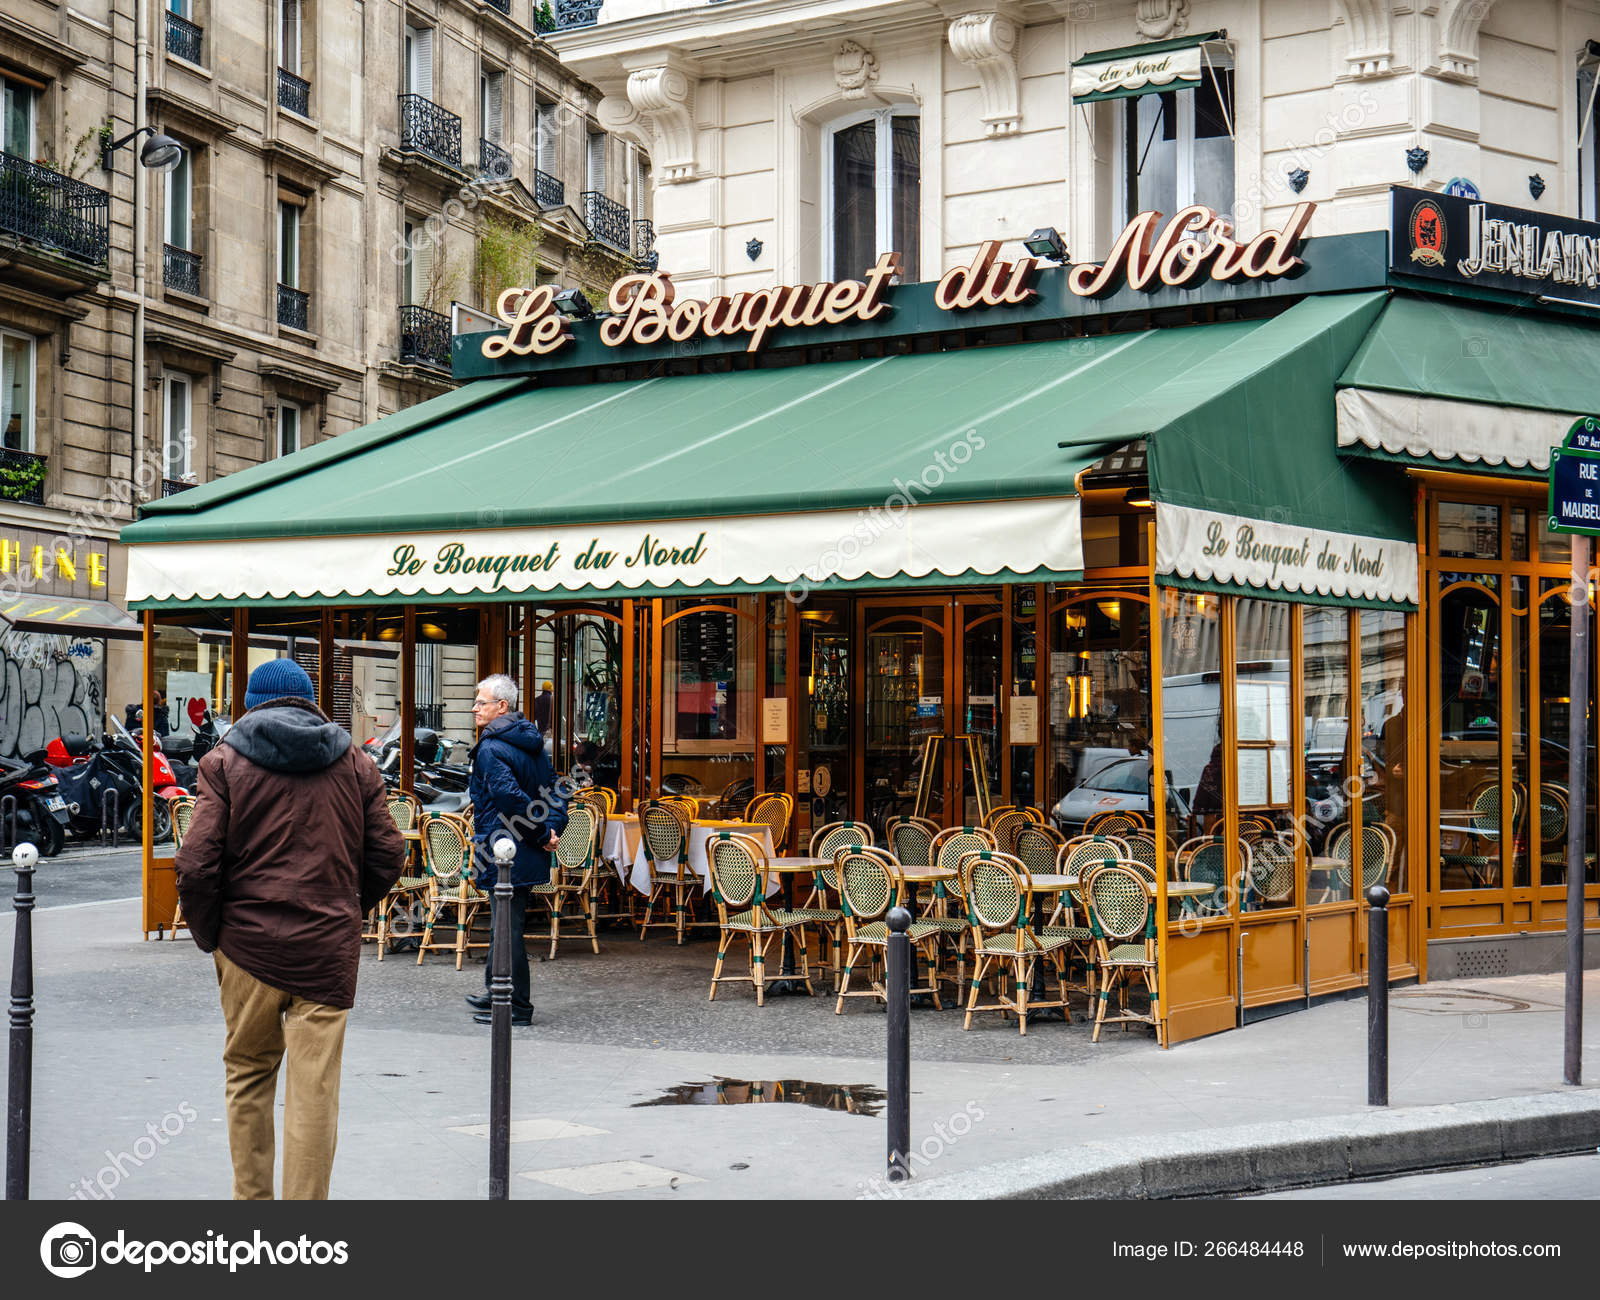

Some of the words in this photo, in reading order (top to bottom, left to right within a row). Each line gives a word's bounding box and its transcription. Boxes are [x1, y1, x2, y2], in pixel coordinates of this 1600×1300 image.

[1099, 66, 1122, 83] du
[1126, 56, 1172, 79] Nord
[481, 284, 572, 359] Le
[600, 252, 901, 353] Bouquet
[934, 240, 1037, 311] du
[1068, 202, 1316, 298] Nord
[1579, 463, 1598, 480] RUE
[1585, 488, 1593, 498] DE
[0, 538, 105, 586] HINE
[387, 543, 426, 576] Le
[433, 541, 561, 589] Bouquet
[574, 537, 618, 570] du
[625, 531, 707, 567] Nord
[1202, 520, 1230, 557] Le
[1235, 524, 1310, 580] Bouquet
[1316, 539, 1341, 572] du
[1344, 542, 1385, 578] Nord
